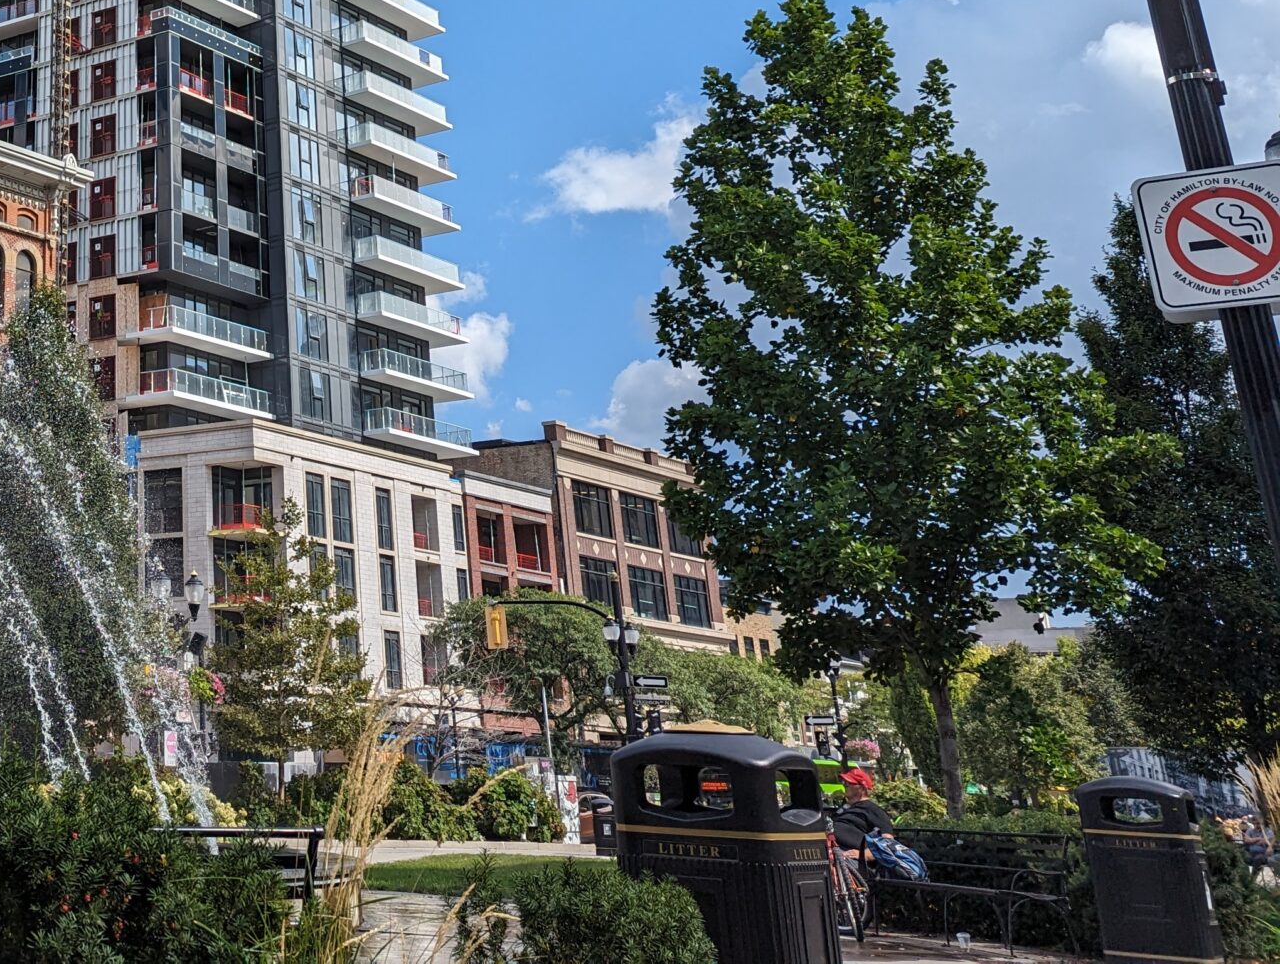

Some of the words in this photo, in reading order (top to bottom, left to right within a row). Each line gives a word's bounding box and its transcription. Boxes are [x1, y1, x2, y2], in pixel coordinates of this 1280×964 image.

[1154, 214, 1166, 234] CITY
[1162, 200, 1172, 214] OF
[1171, 177, 1220, 203] HAMILTON
[1223, 177, 1265, 194] BY-LAW
[1172, 270, 1221, 297] MAXIMUM
[1224, 279, 1271, 297] PENALTY
[658, 842, 721, 858] LITTER
[793, 848, 822, 860] LITTER
